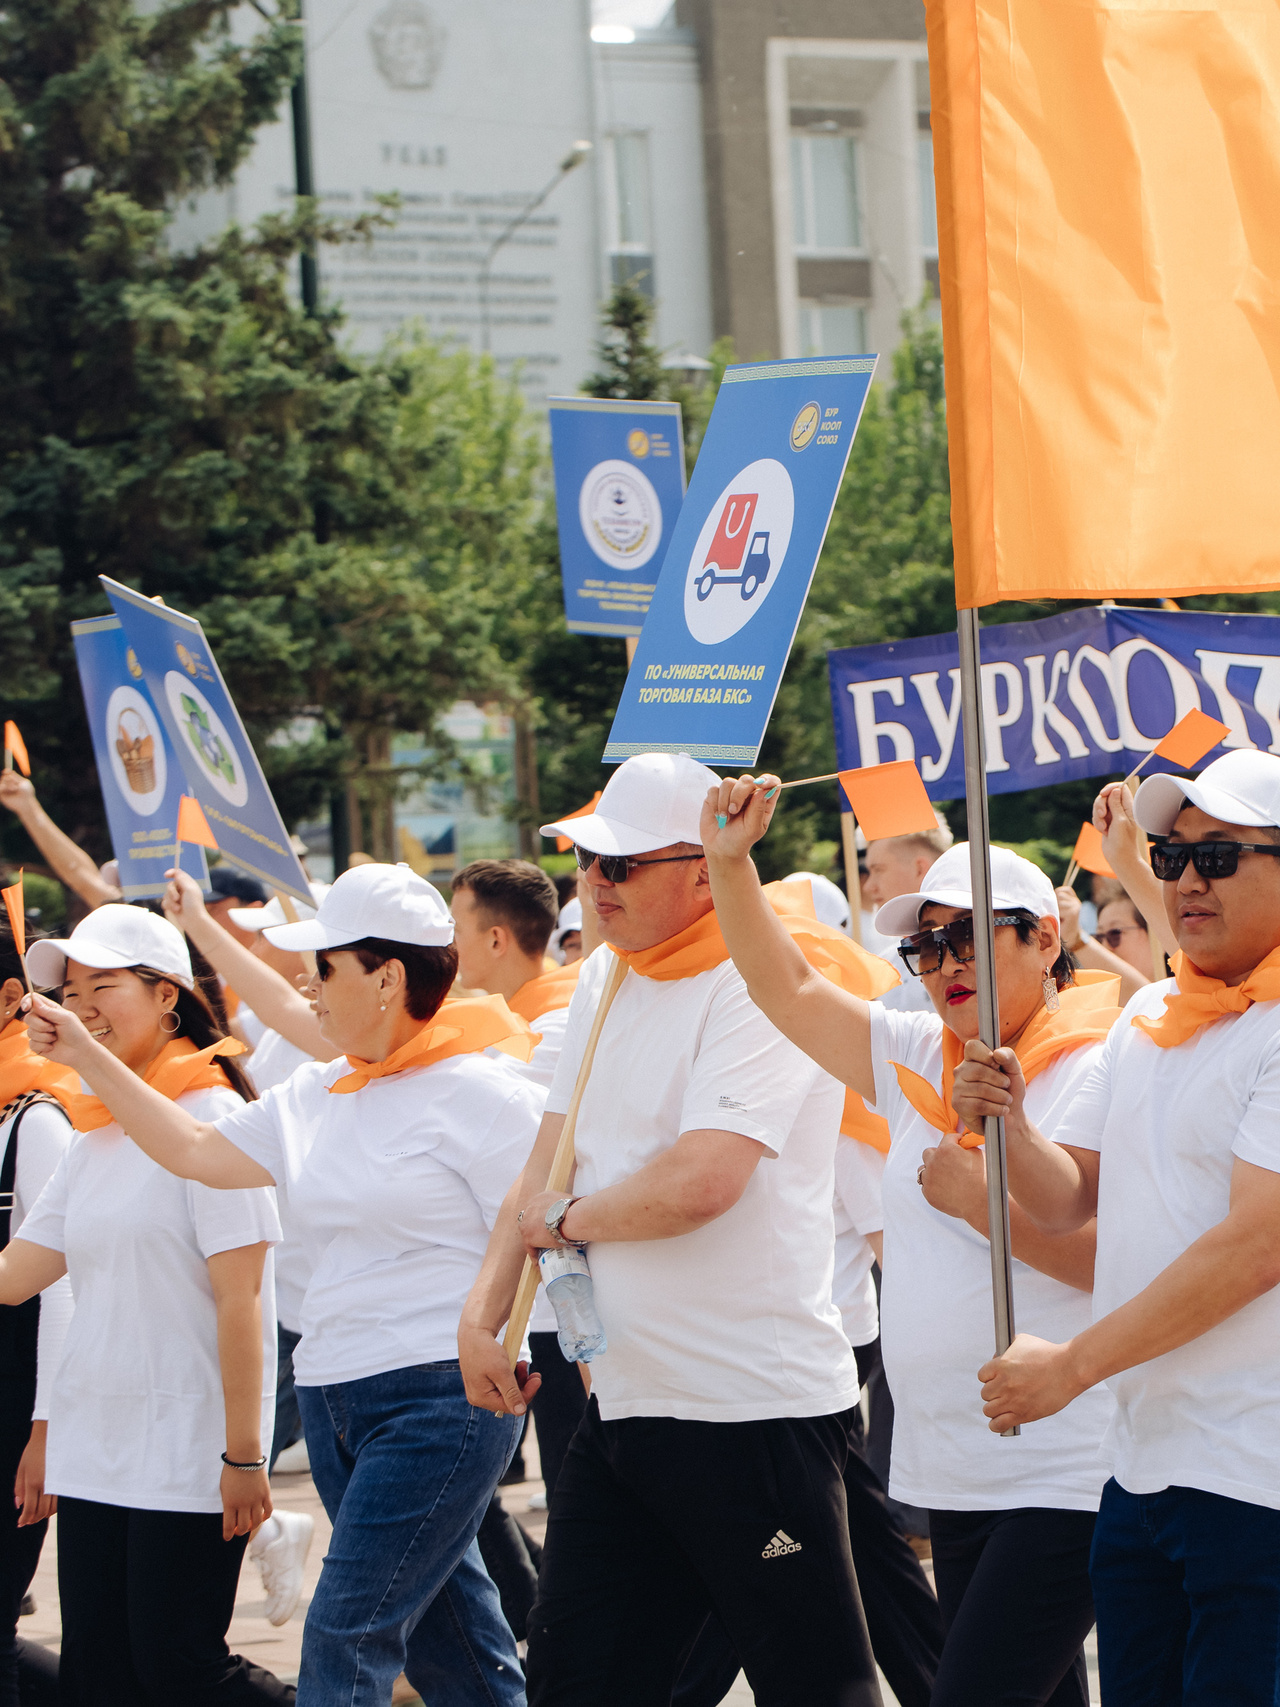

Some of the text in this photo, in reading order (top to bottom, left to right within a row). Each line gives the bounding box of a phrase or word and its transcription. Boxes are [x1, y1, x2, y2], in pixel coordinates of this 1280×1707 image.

[824, 408, 839, 417] БУР
[820, 421, 842, 431] КООП
[816, 435, 838, 445] СОЮЗ
[644, 664, 766, 681] ПО «УНИВЕРСАЛЬНАЯ
[638, 688, 753, 705] ТОРГОВАЯ БАЗА БКС»
[761, 1542, 803, 1559] adidas
